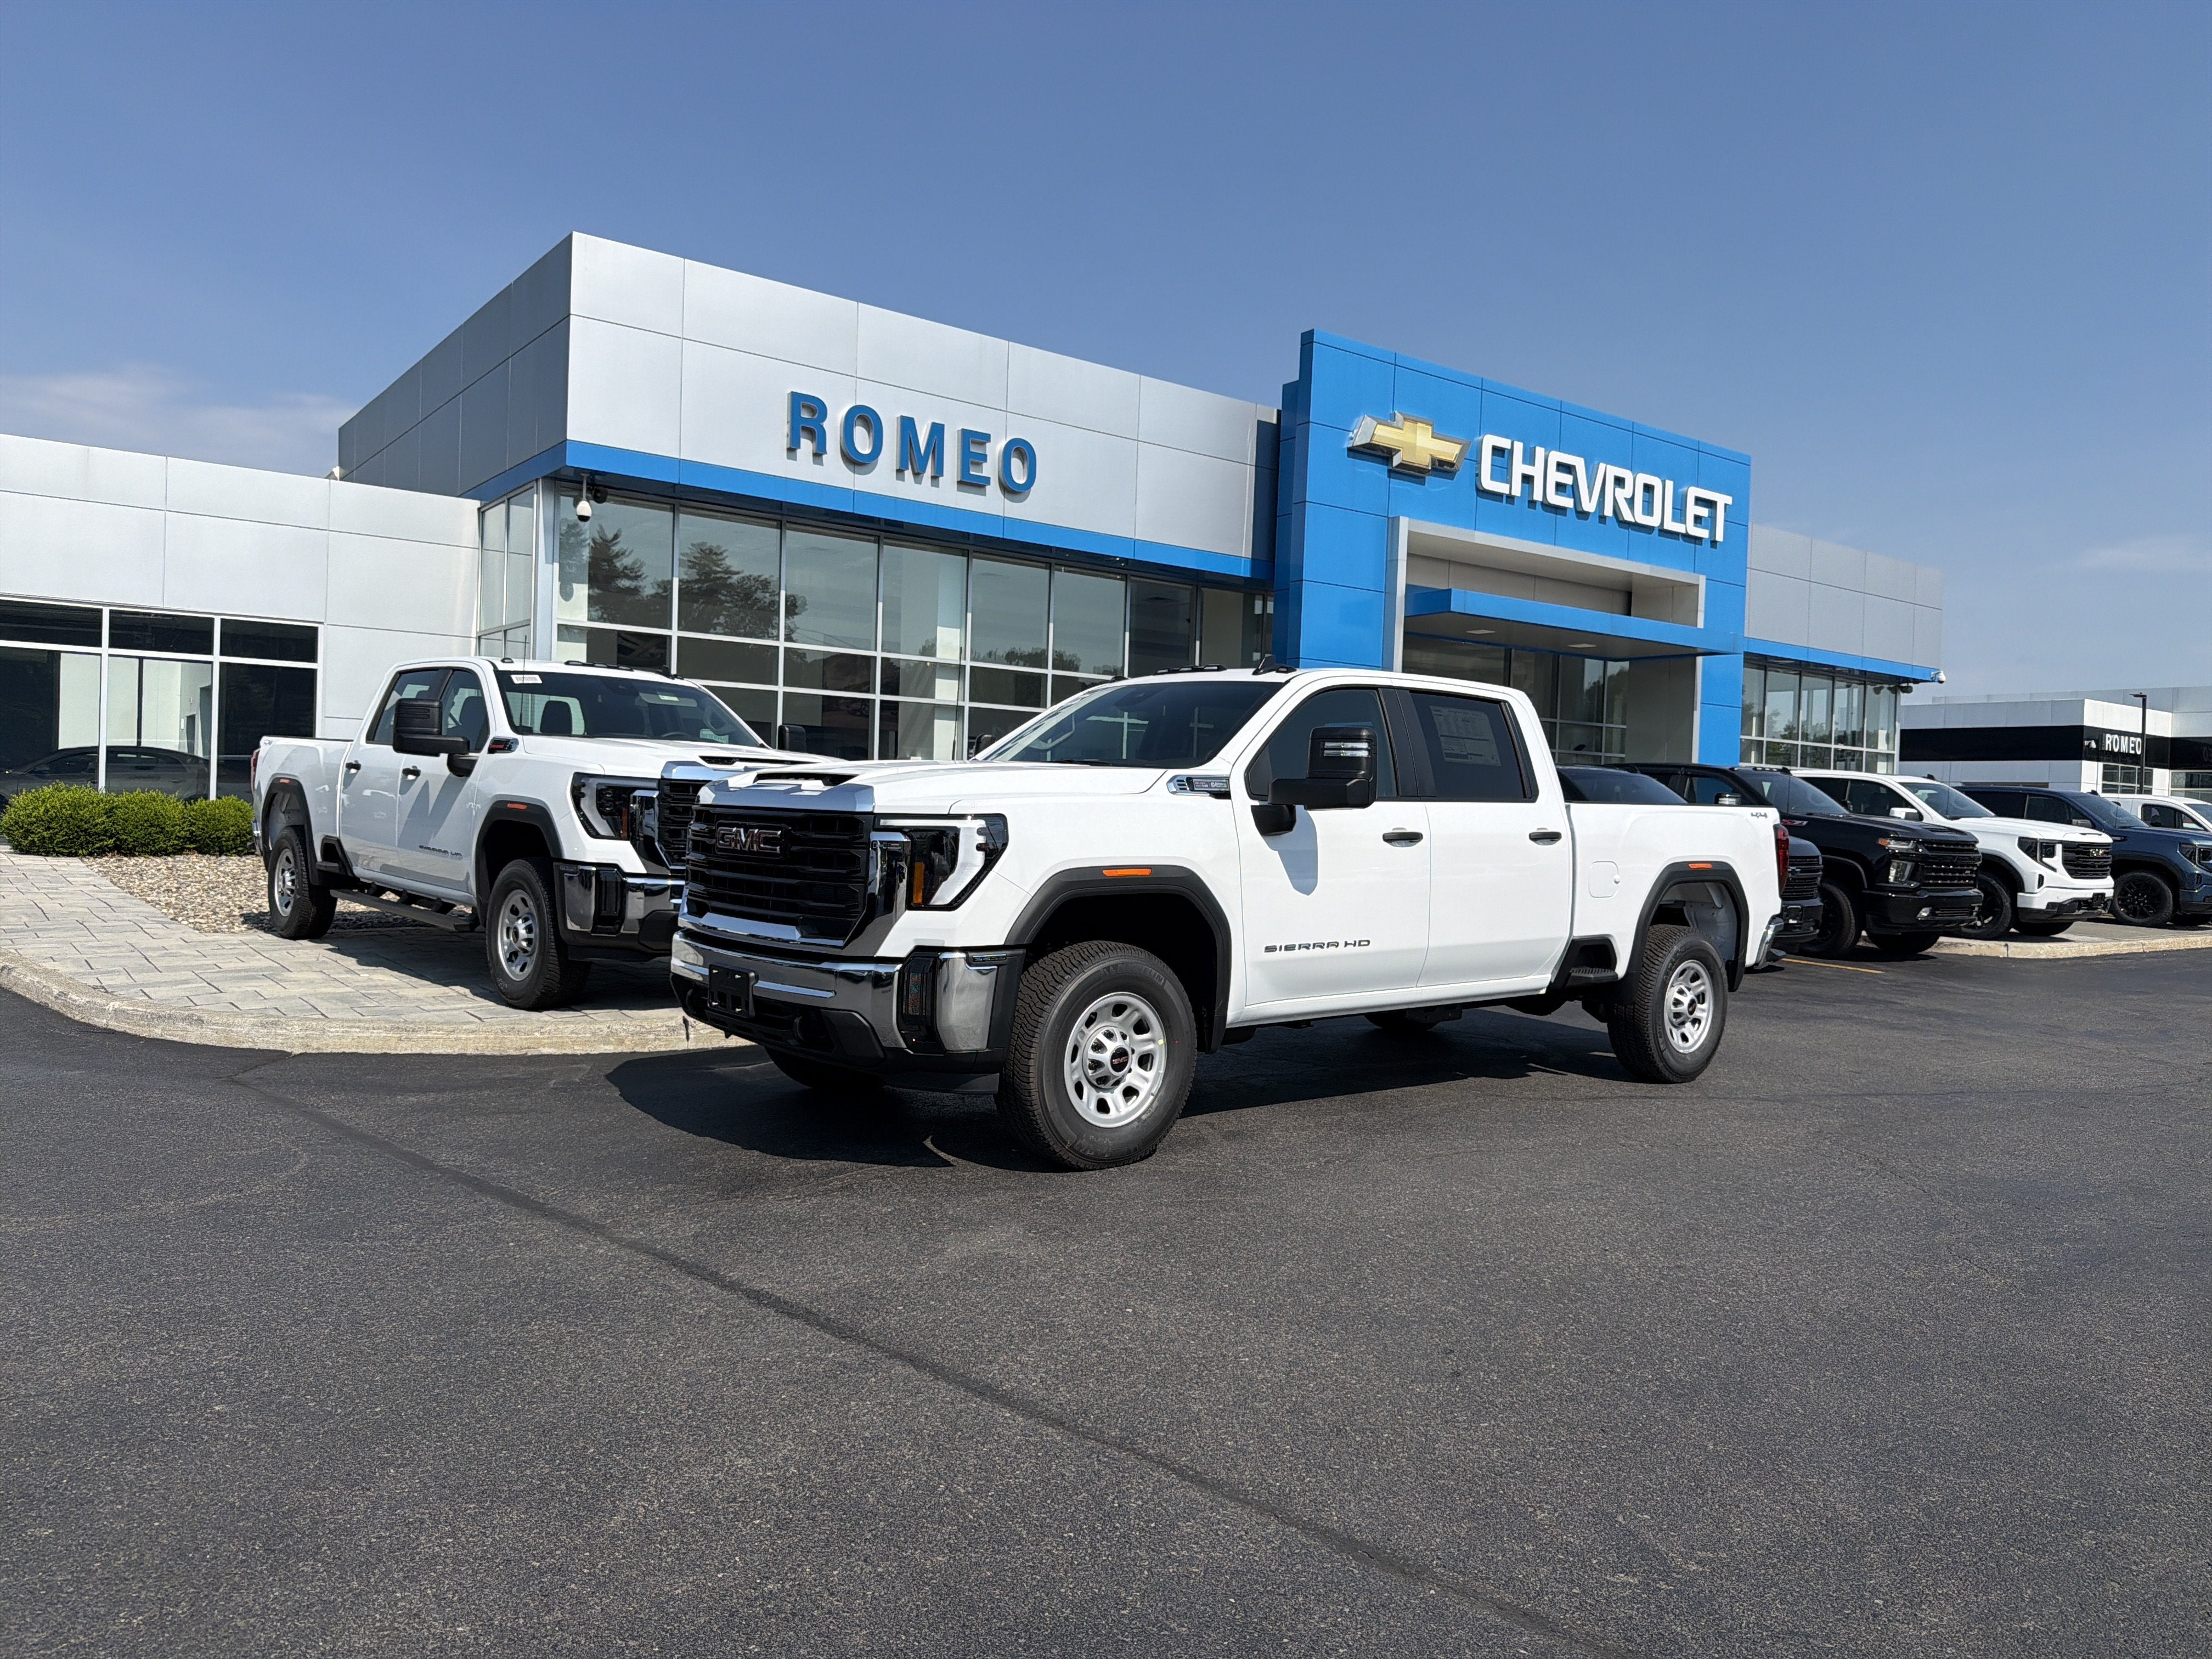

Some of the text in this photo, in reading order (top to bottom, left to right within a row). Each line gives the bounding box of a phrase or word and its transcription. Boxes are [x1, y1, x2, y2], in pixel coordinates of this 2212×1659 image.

[787, 391, 1037, 493] ROMEO
[1477, 433, 1733, 542] CHEVROLET
[2105, 733, 2142, 755] ROMEO
[716, 826, 782, 854] GMC
[1263, 939, 1371, 953] SIERRA HD
